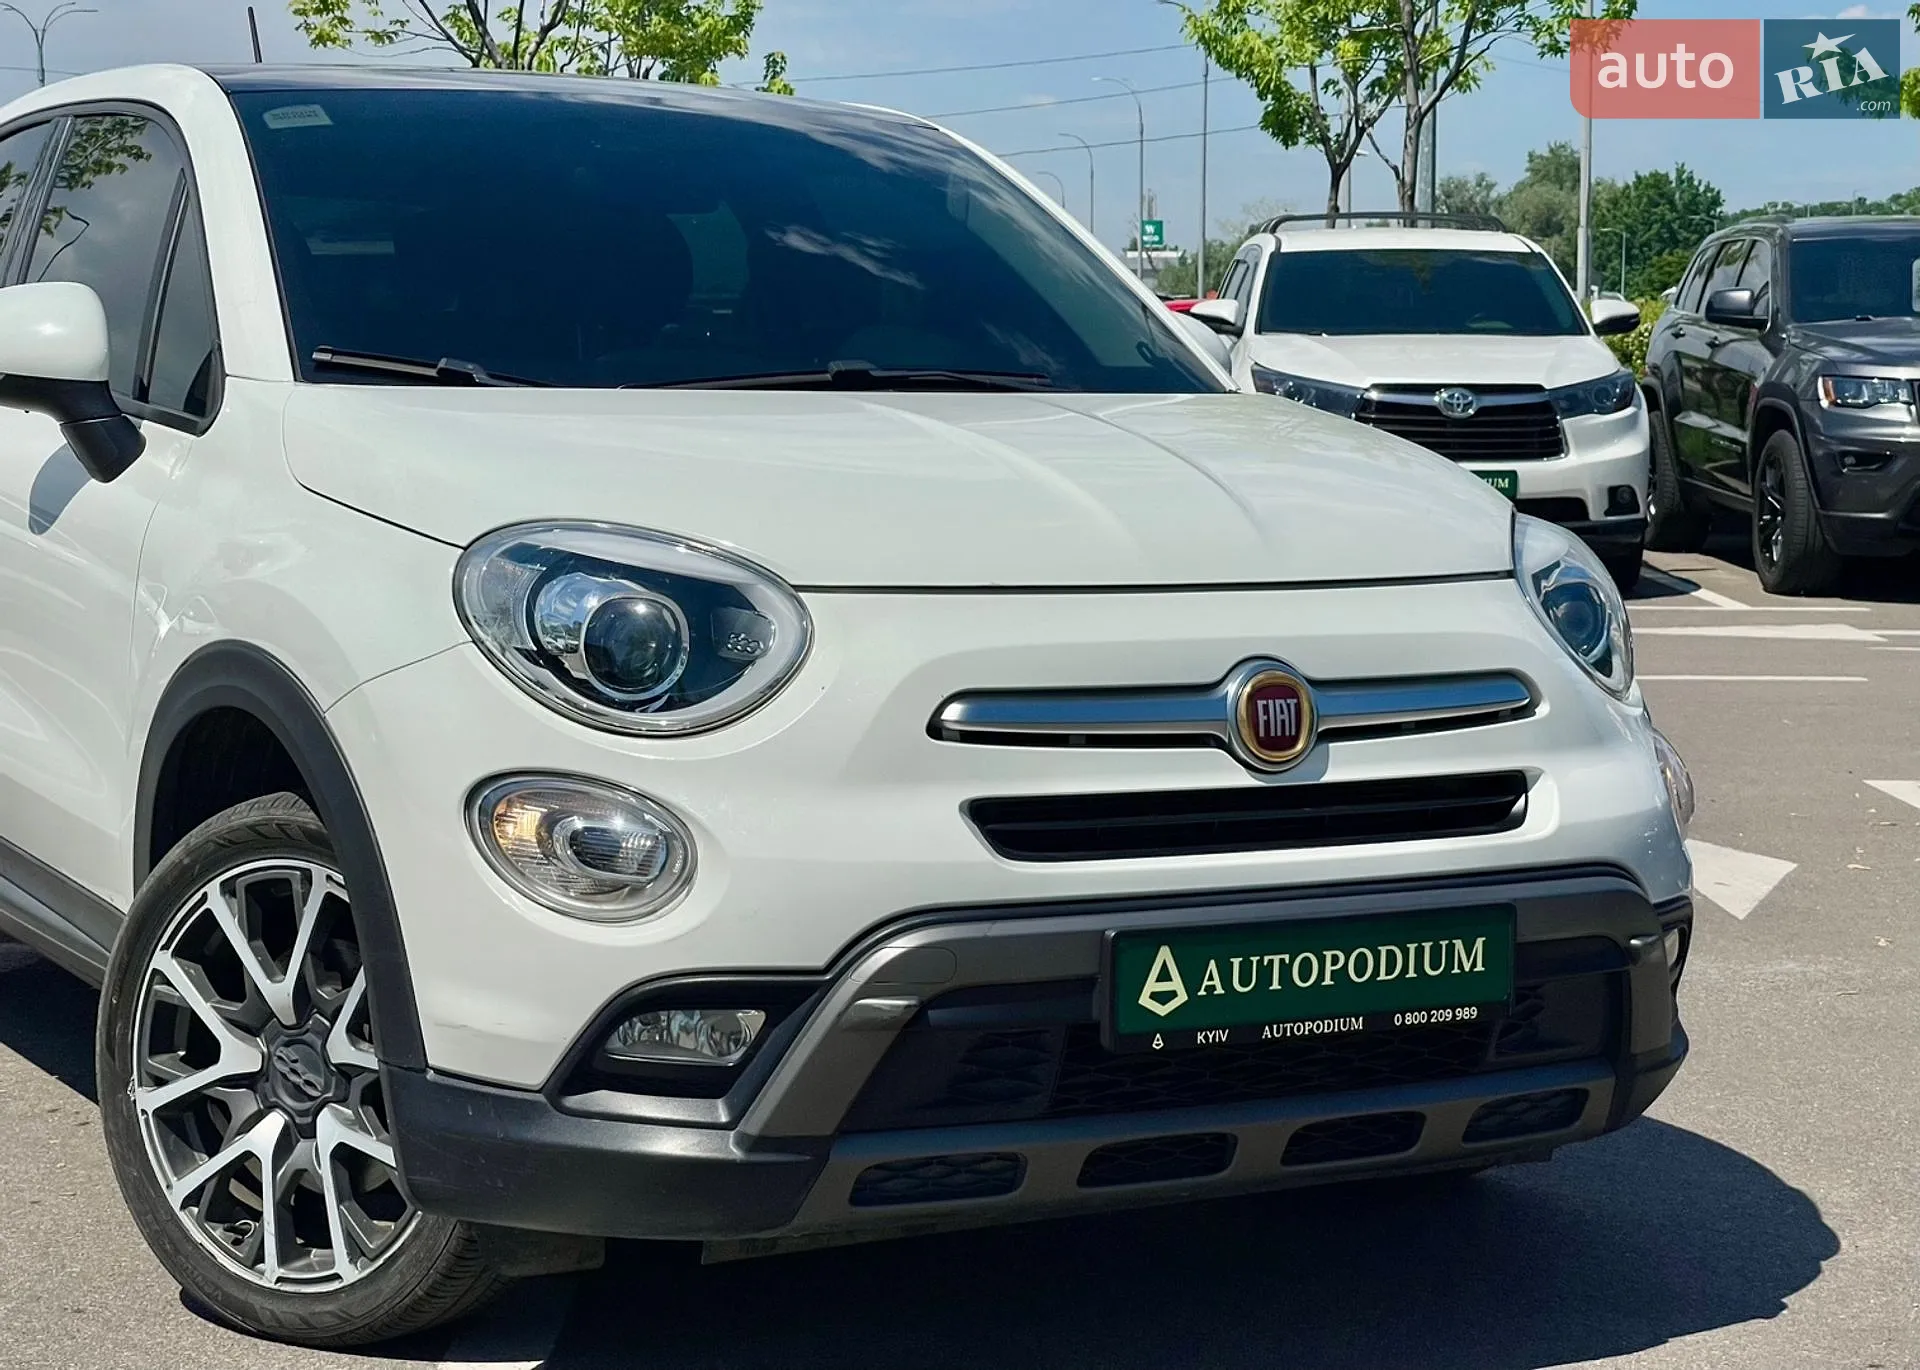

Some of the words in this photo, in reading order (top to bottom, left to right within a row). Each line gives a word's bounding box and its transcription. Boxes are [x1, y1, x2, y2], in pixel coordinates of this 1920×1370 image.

[1257, 698, 1298, 737] FIAT
[1198, 936, 1487, 996] AUTOPODIUM
[1196, 1029, 1229, 1045] KYIV
[1261, 1016, 1364, 1040] AUTOPODIUM
[1393, 1013, 1403, 1026] 0
[1404, 1010, 1428, 1025] 800
[1430, 1008, 1453, 1023] 209
[1454, 1006, 1478, 1021] 989
